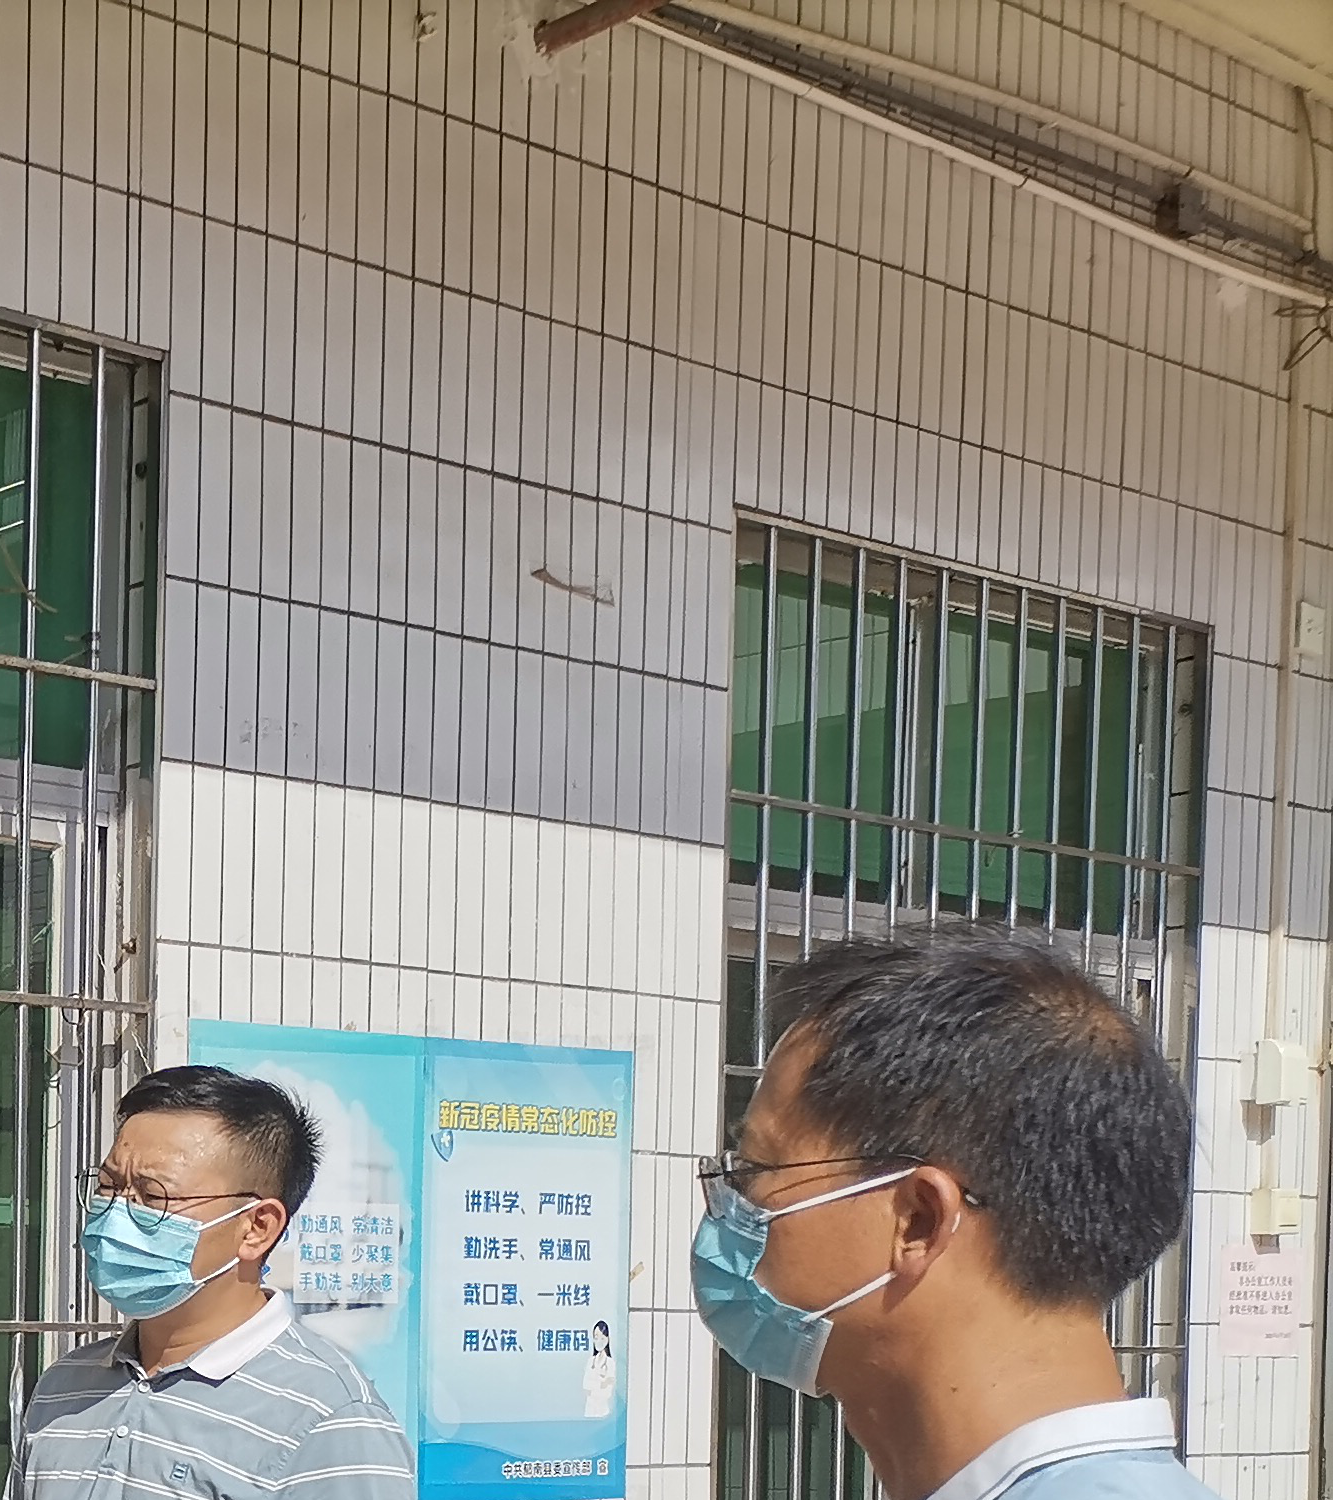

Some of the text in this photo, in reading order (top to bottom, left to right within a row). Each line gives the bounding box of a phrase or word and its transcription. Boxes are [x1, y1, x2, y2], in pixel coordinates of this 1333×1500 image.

[438, 1099, 618, 1138] 新冠疫情常态化防控
[299, 1214, 393, 1235] 勤通风 常清洁
[300, 1243, 393, 1263] 戴口罩 少聚集
[299, 1272, 393, 1292] 手勤洗 别大意
